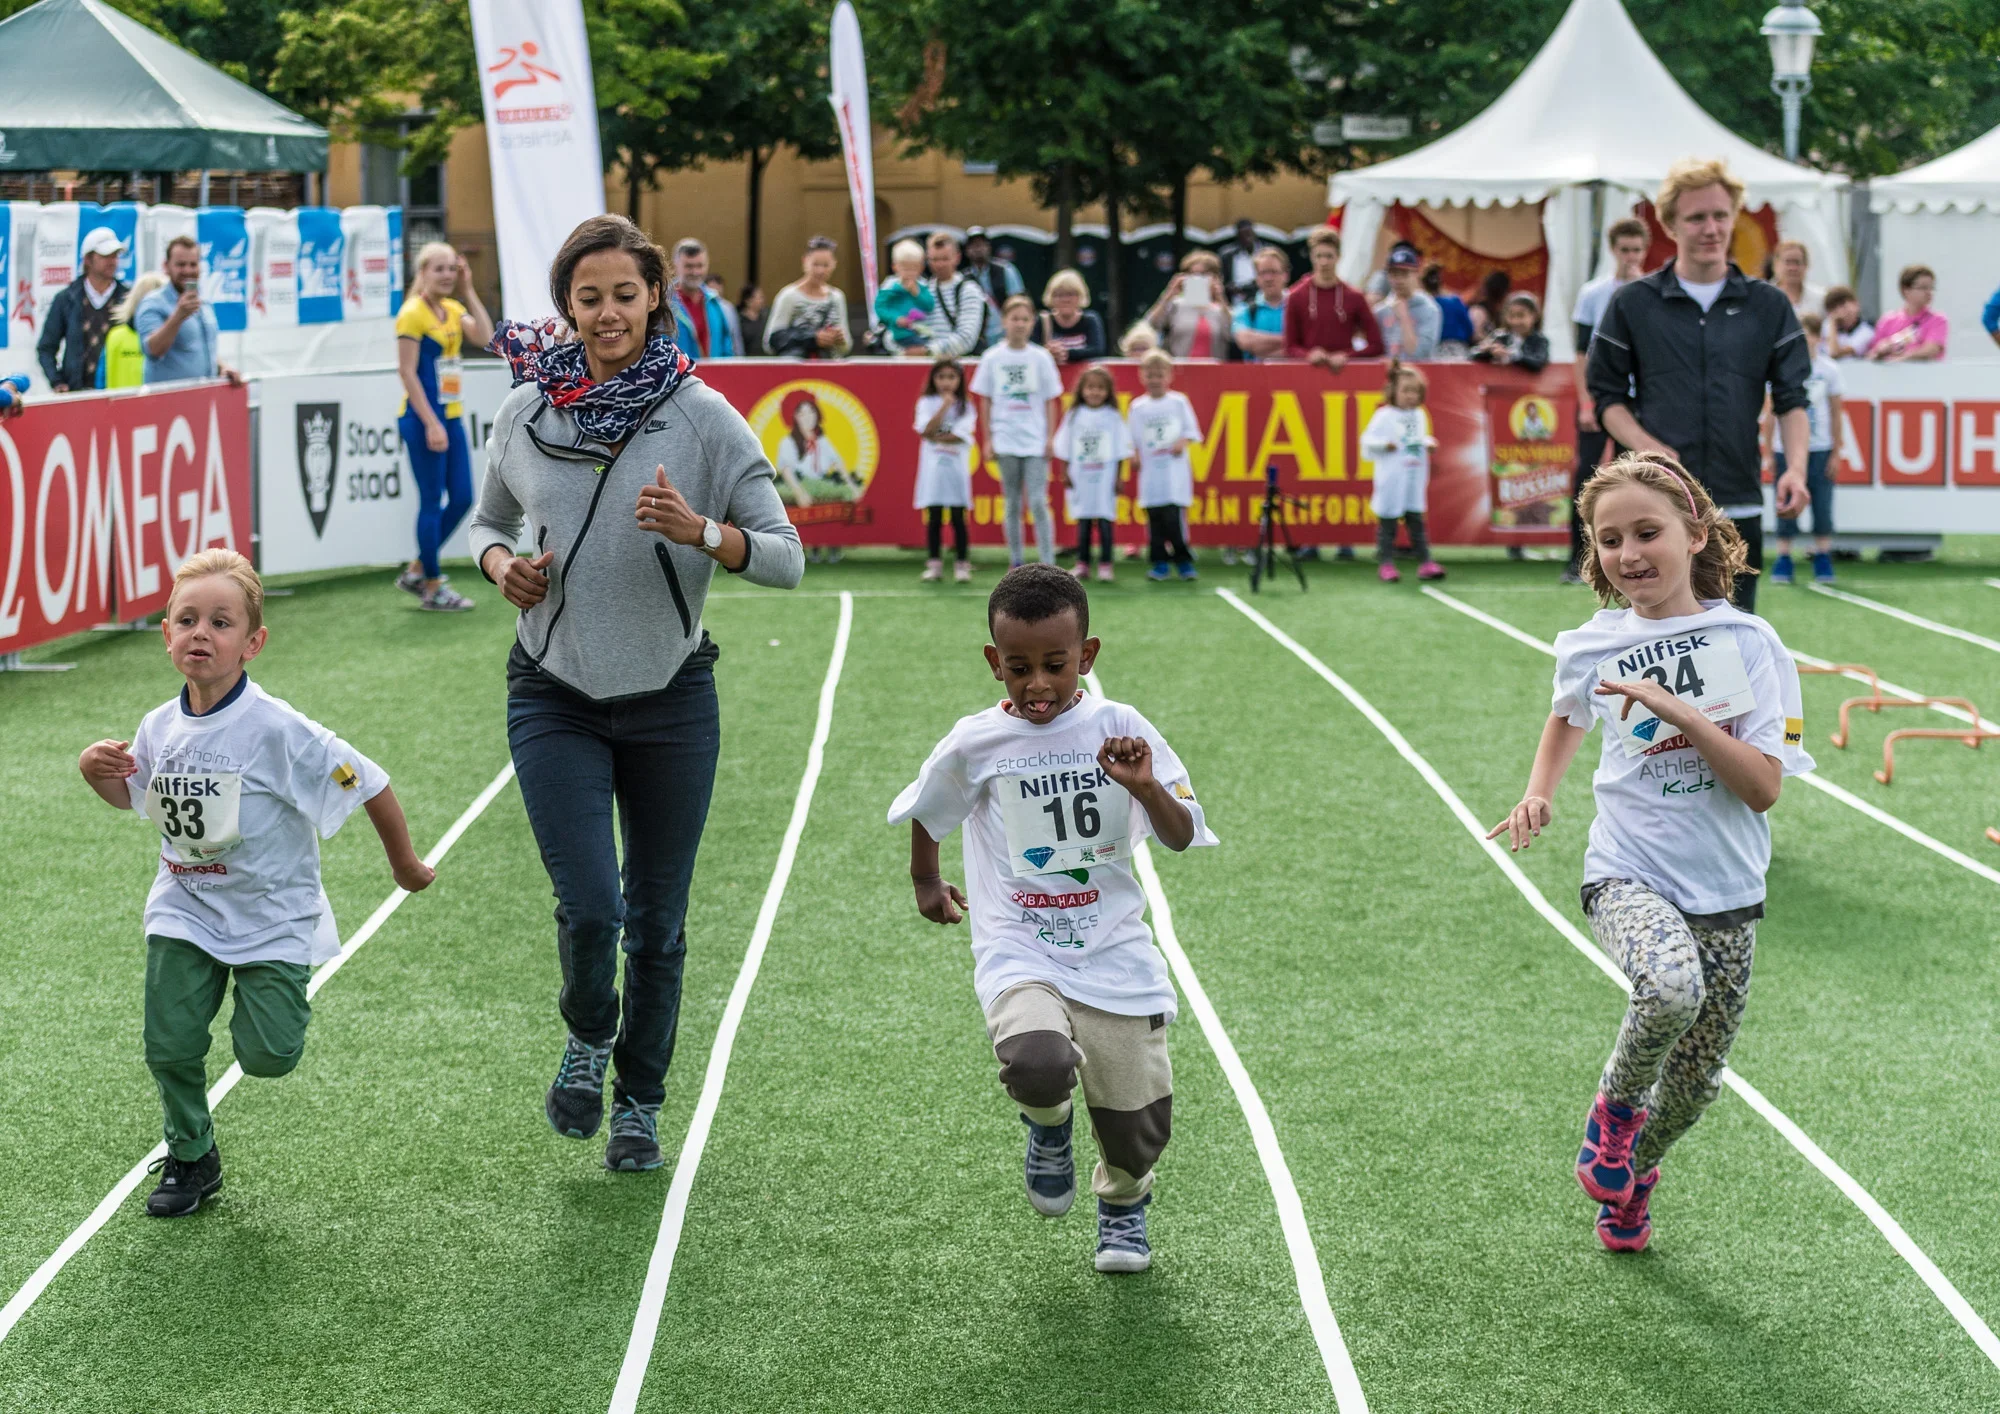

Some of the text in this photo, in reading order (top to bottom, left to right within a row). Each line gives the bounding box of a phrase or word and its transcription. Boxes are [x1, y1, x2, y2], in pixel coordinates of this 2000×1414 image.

[649, 419, 668, 429] NIKE
[348, 462, 400, 502] stad
[35, 400, 237, 625] OMEGA
[1617, 634, 1710, 677] Nilfisk
[996, 749, 1093, 773] Stockholm
[1639, 755, 1711, 780] Athlet
[1020, 767, 1111, 799] Nilfisk
[1662, 774, 1715, 797] Kids
[161, 797, 205, 840] 33
[1042, 791, 1101, 842] 16
[1027, 890, 1098, 909] BAUHAUS
[1021, 909, 1098, 933] Athletics
[1036, 927, 1085, 949] Kids
